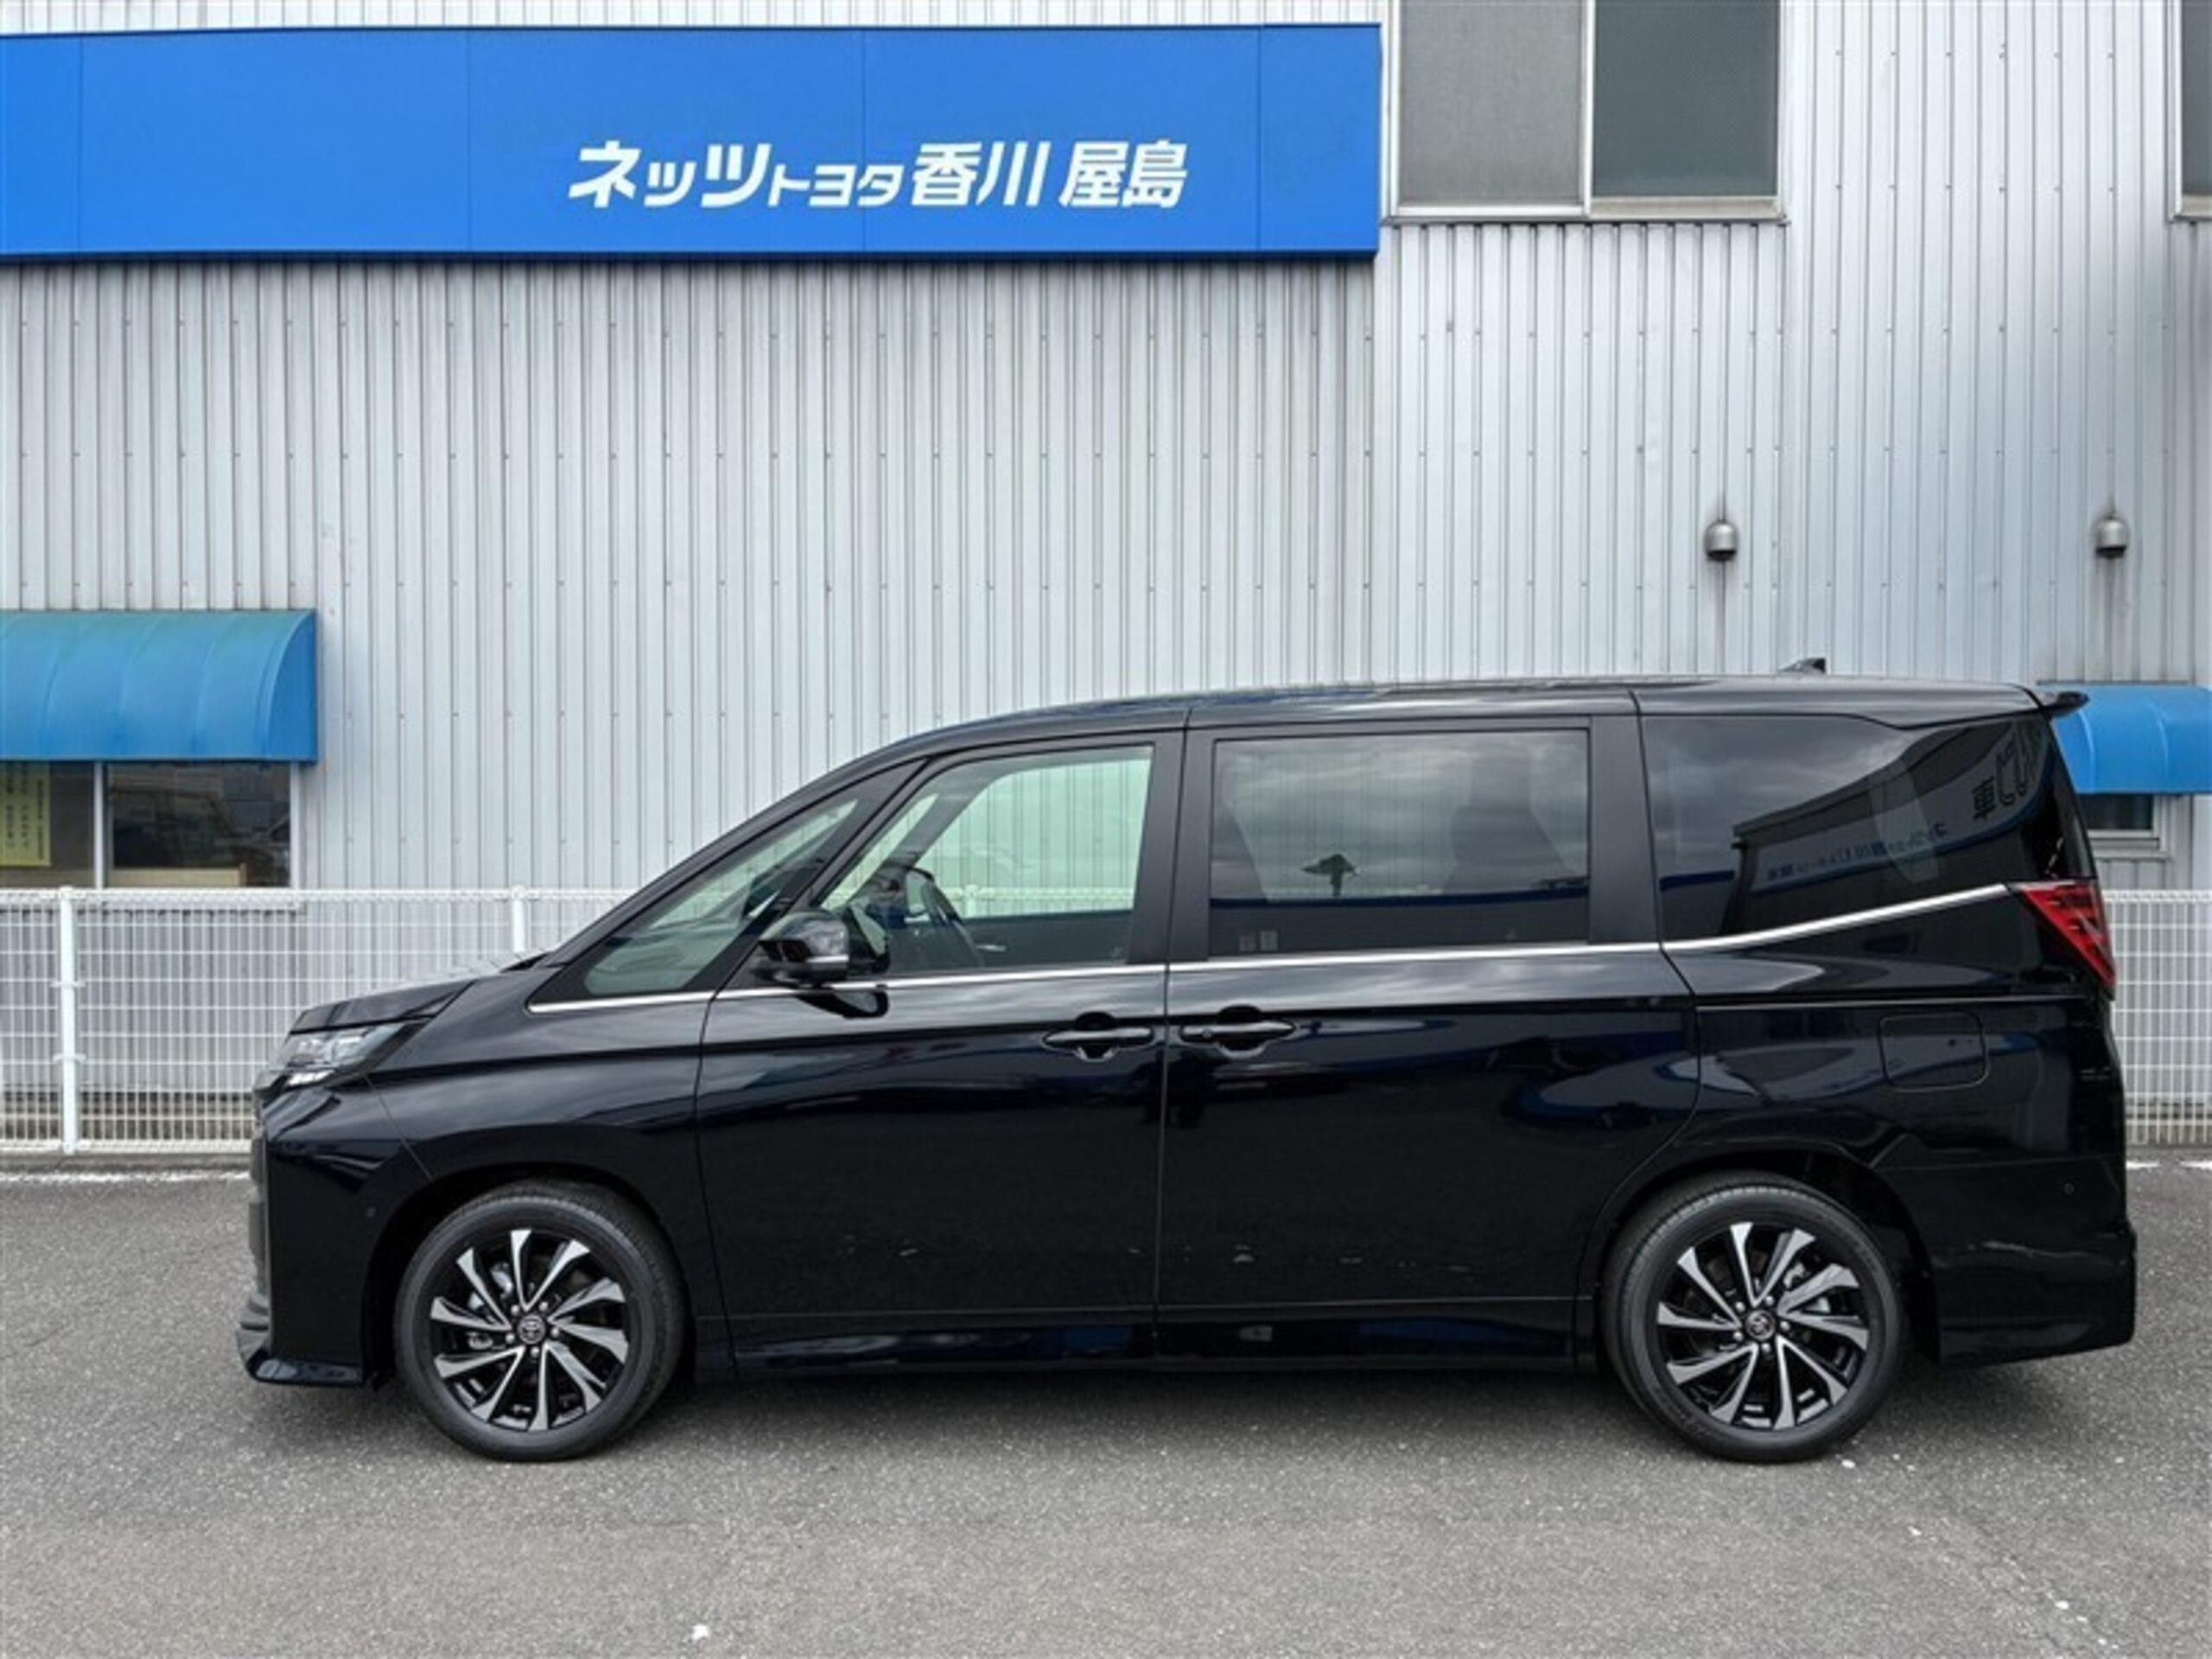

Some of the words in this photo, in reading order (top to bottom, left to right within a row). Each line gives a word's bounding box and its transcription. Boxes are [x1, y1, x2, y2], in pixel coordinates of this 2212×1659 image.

[569, 140, 1051, 208] ネッツトヨタ香川
[1058, 140, 1187, 208] 屋島
